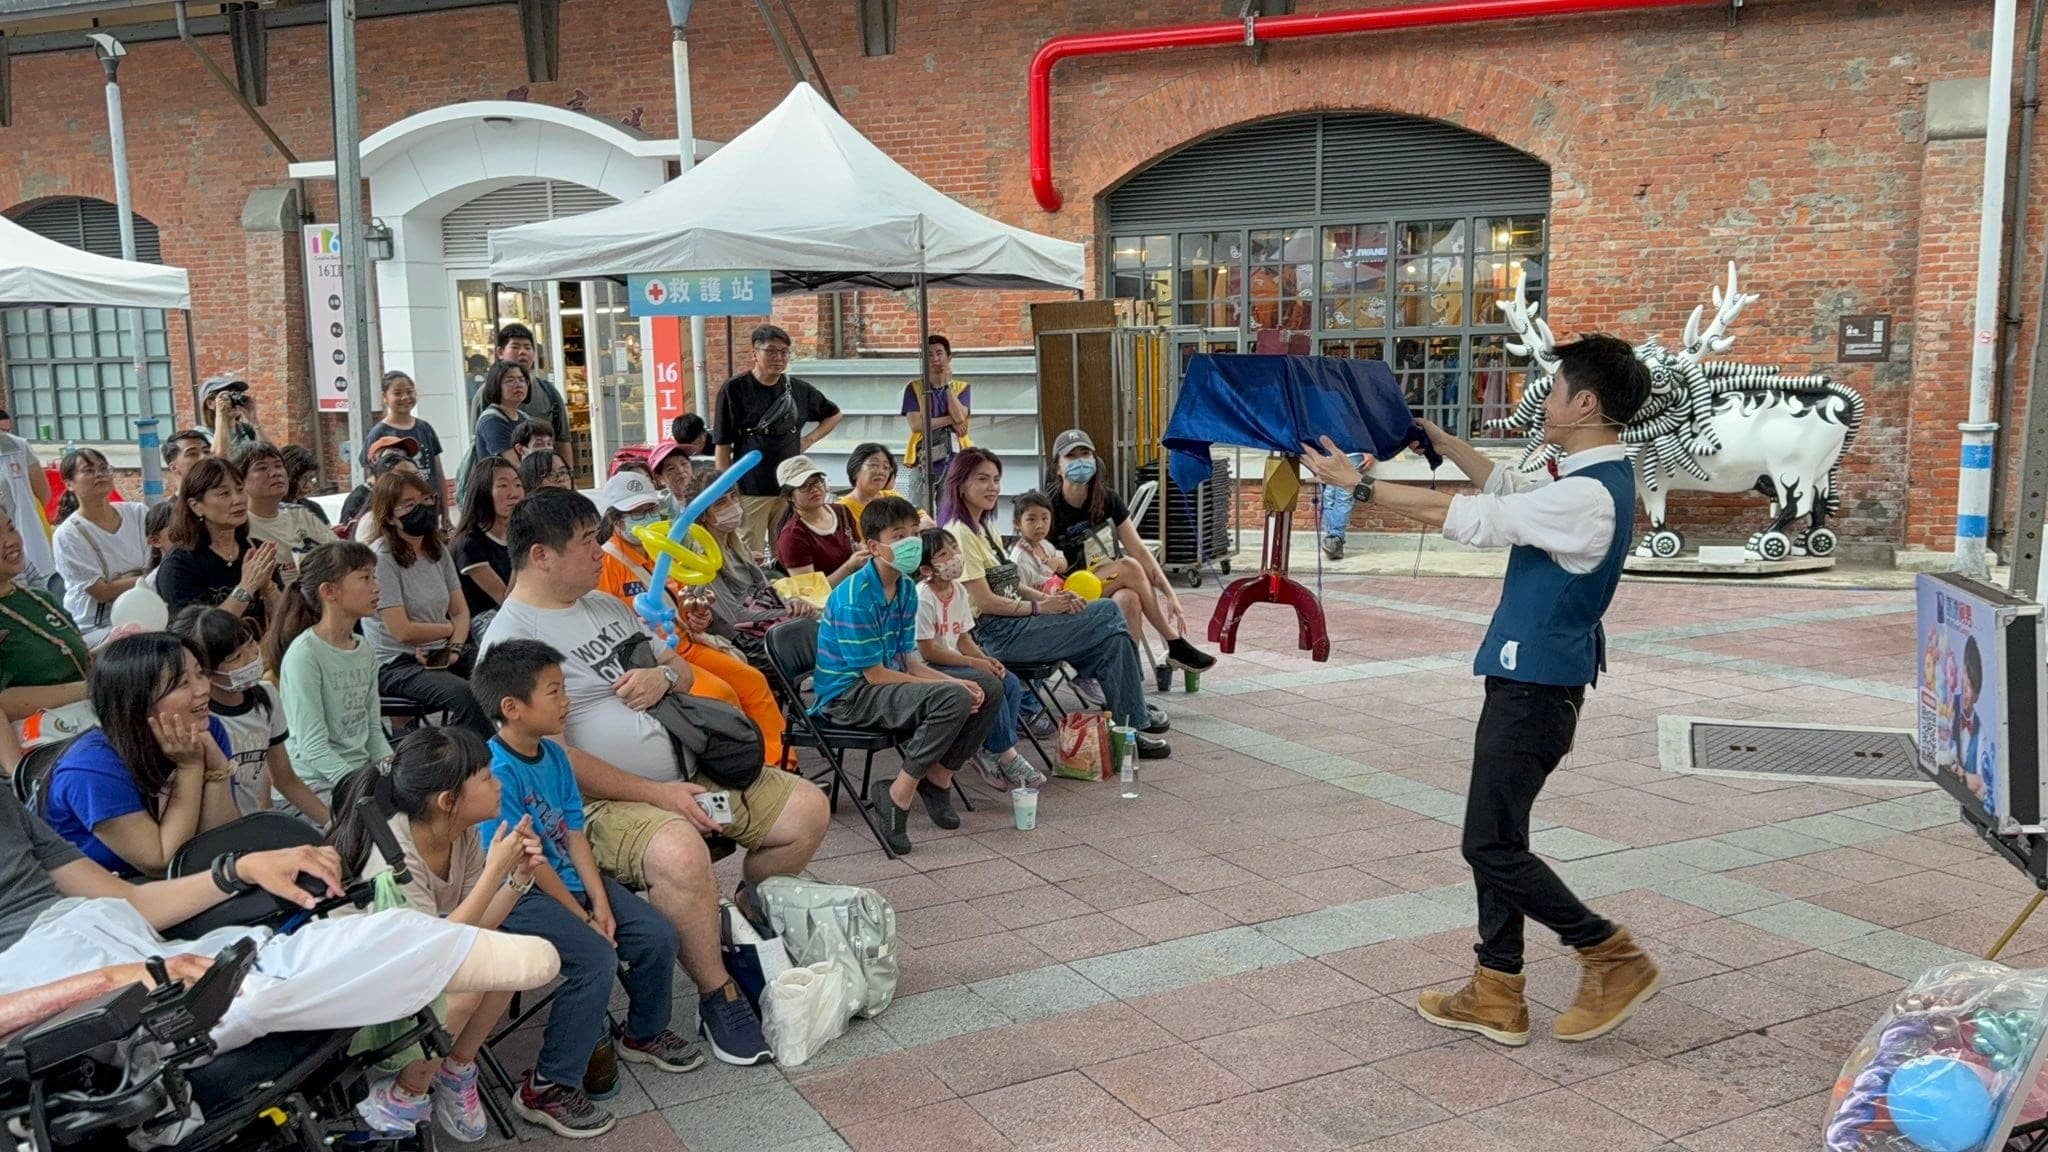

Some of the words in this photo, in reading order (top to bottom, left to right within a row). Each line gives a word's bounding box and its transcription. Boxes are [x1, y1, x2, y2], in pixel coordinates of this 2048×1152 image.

[669, 276, 754, 303] 救護站
[570, 627, 616, 663] WOK
[608, 621, 627, 639] IT
